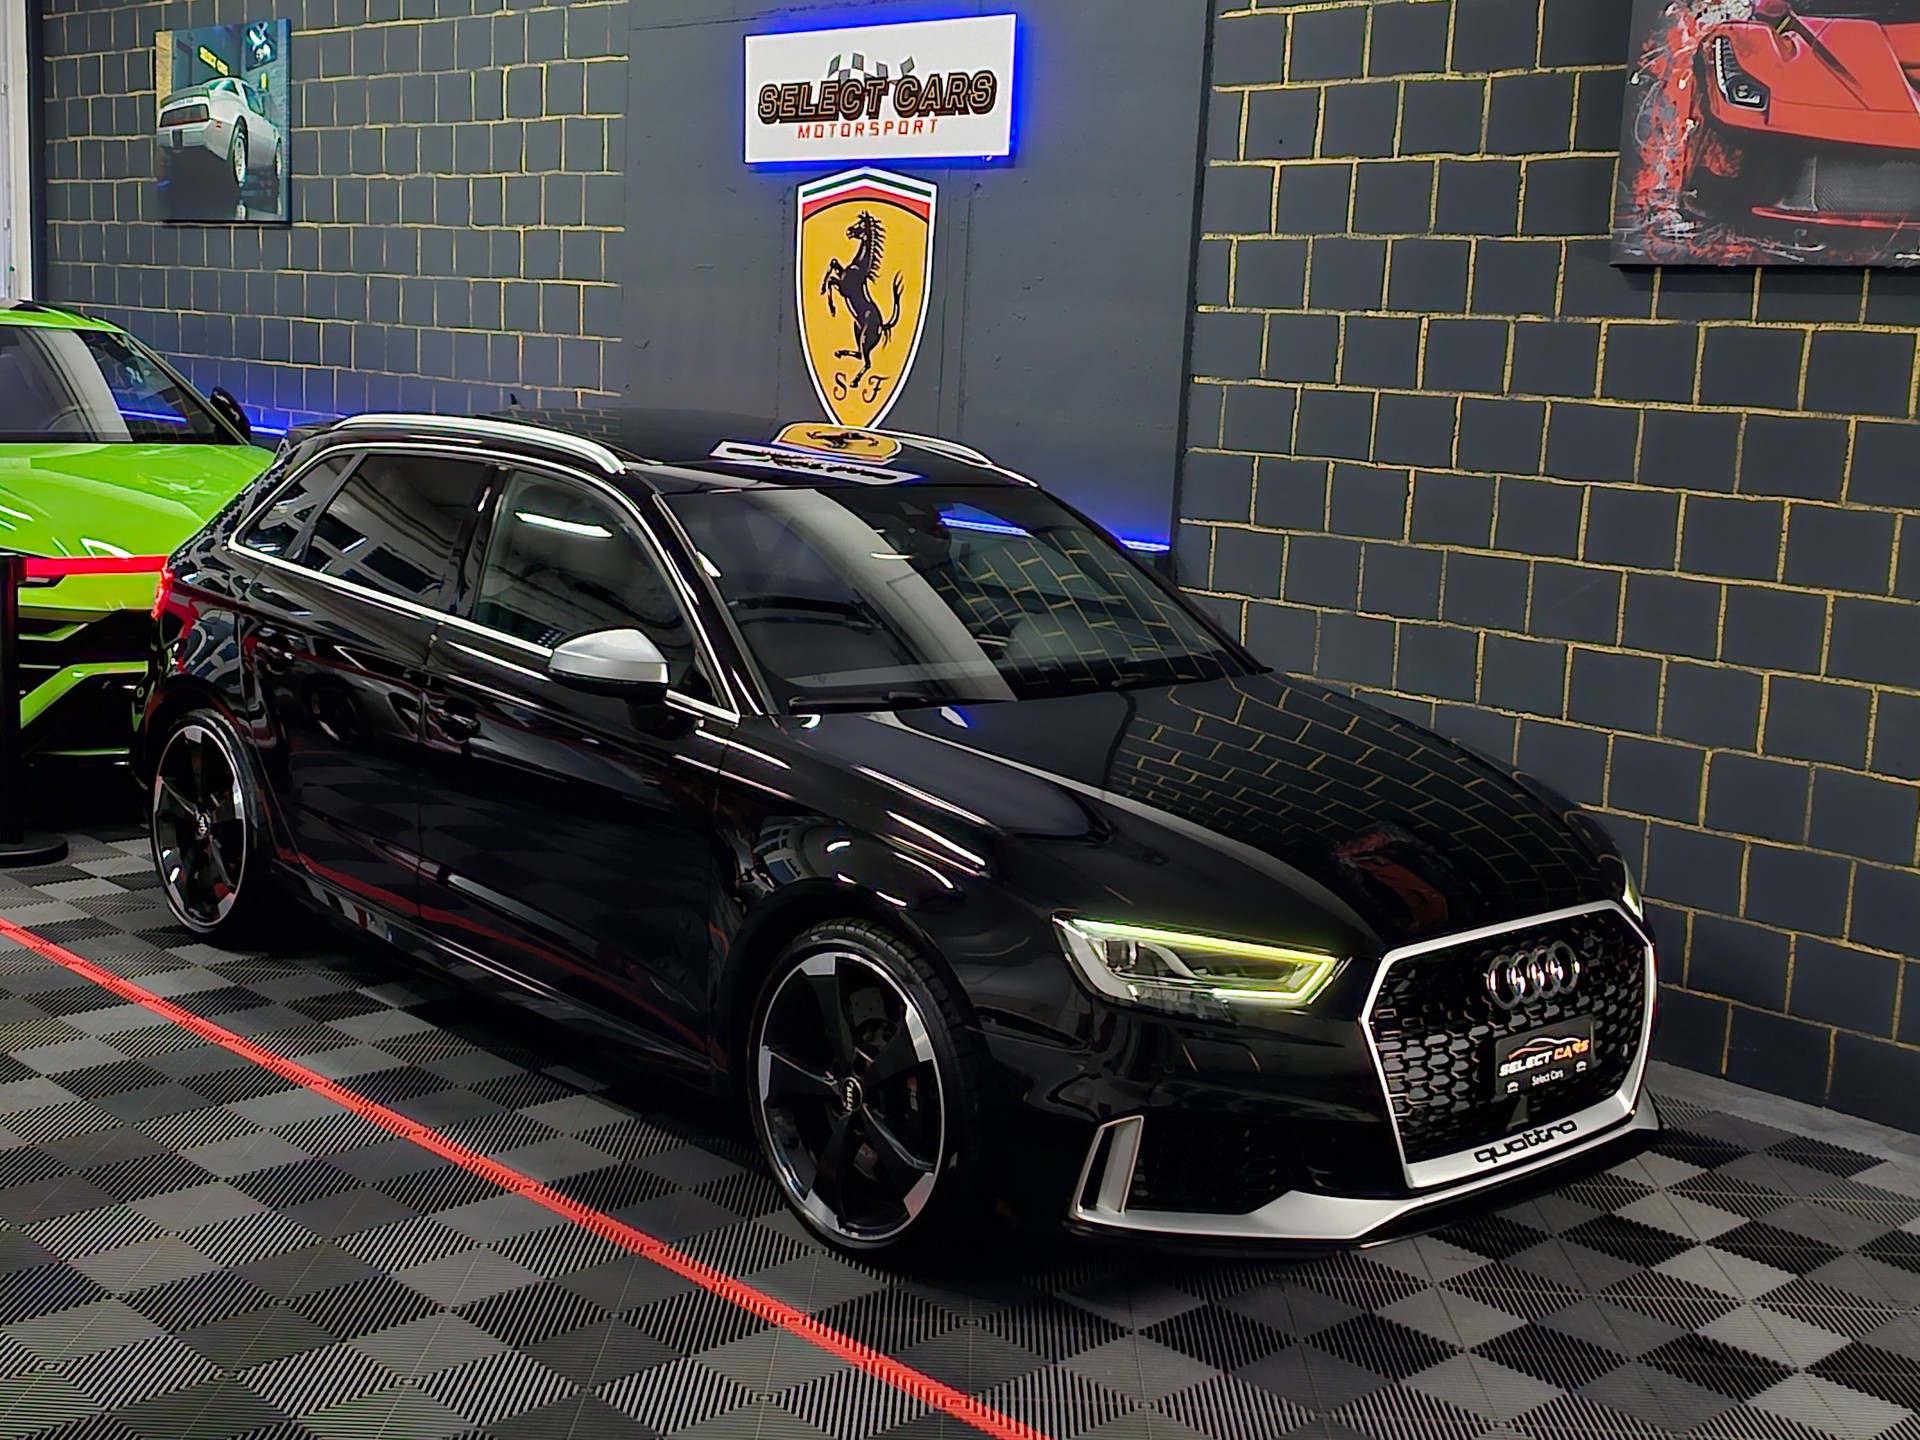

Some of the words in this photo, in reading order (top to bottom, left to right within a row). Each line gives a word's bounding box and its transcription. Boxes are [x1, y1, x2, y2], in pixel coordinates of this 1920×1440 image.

[758, 77, 891, 124] SELECT
[893, 70, 997, 118] CARS
[797, 119, 938, 139] MOTORSPORT
[833, 372, 848, 401] S
[862, 375, 889, 403] F
[1499, 1050, 1553, 1077] SELECT
[1553, 1039, 1590, 1060] CARS
[1474, 1119, 1578, 1164] quattro
